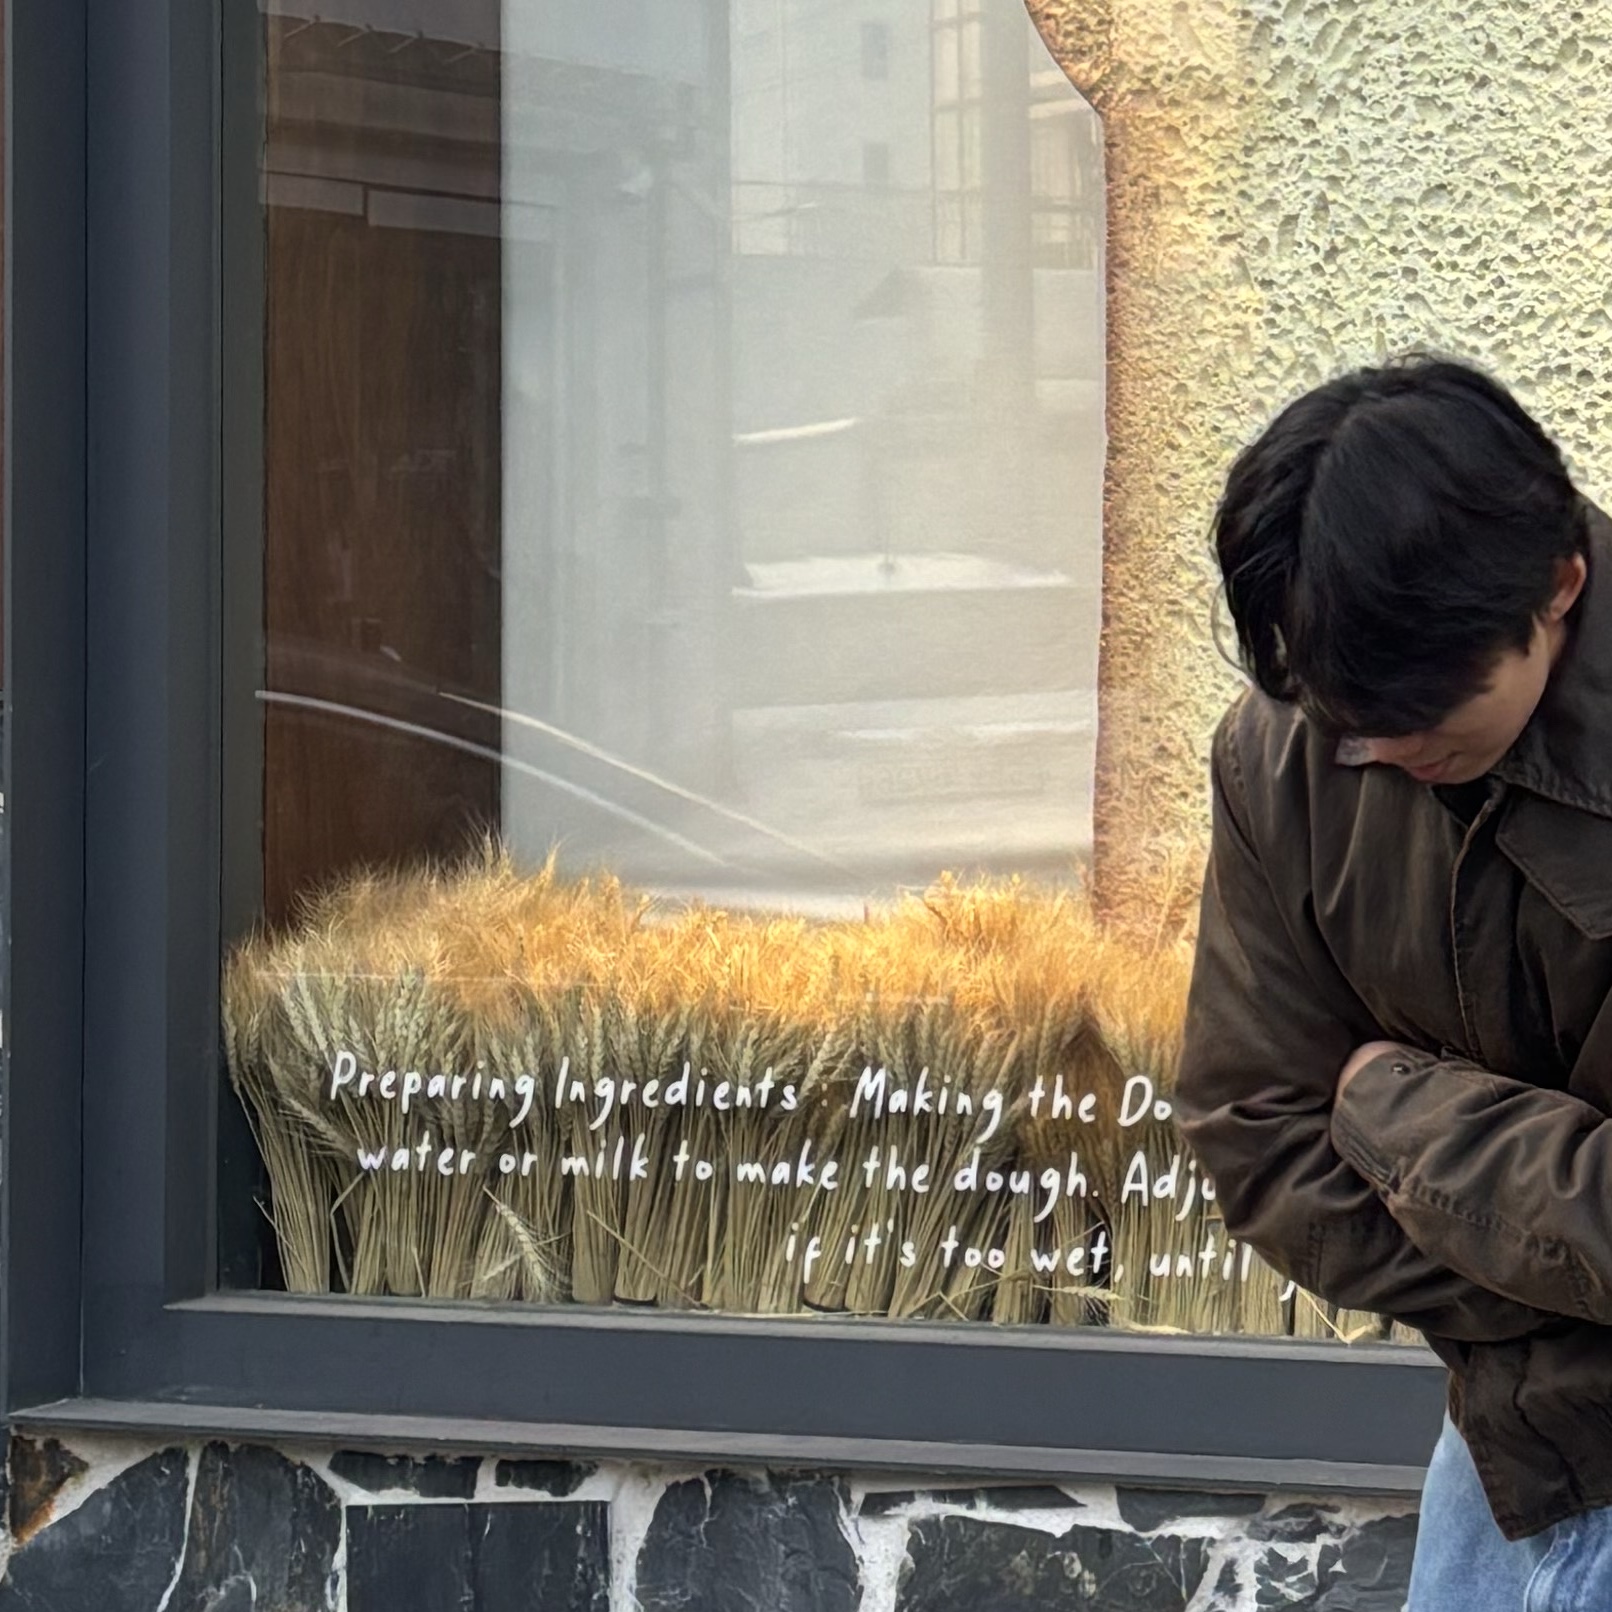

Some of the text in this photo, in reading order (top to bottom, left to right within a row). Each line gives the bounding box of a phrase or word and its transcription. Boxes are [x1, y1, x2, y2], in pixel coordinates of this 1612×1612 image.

[330, 1049, 535, 1128] Preparing
[555, 1056, 797, 1130] Ingredients
[849, 1066, 1004, 1144] Making
[1028, 1074, 1096, 1123] the
[357, 1131, 476, 1176] water
[499, 1151, 538, 1176] or
[561, 1133, 649, 1181] milk
[673, 1140, 713, 1180] to
[737, 1140, 838, 1187] make
[862, 1145, 929, 1193] the
[954, 1147, 1101, 1223] dough.
[1121, 1150, 1216, 1221] Adju
[786, 1222, 822, 1284] if
[845, 1219, 916, 1268] it's
[940, 1225, 1005, 1269] too
[1030, 1231, 1124, 1283] wet,
[1149, 1234, 1253, 1282] until
